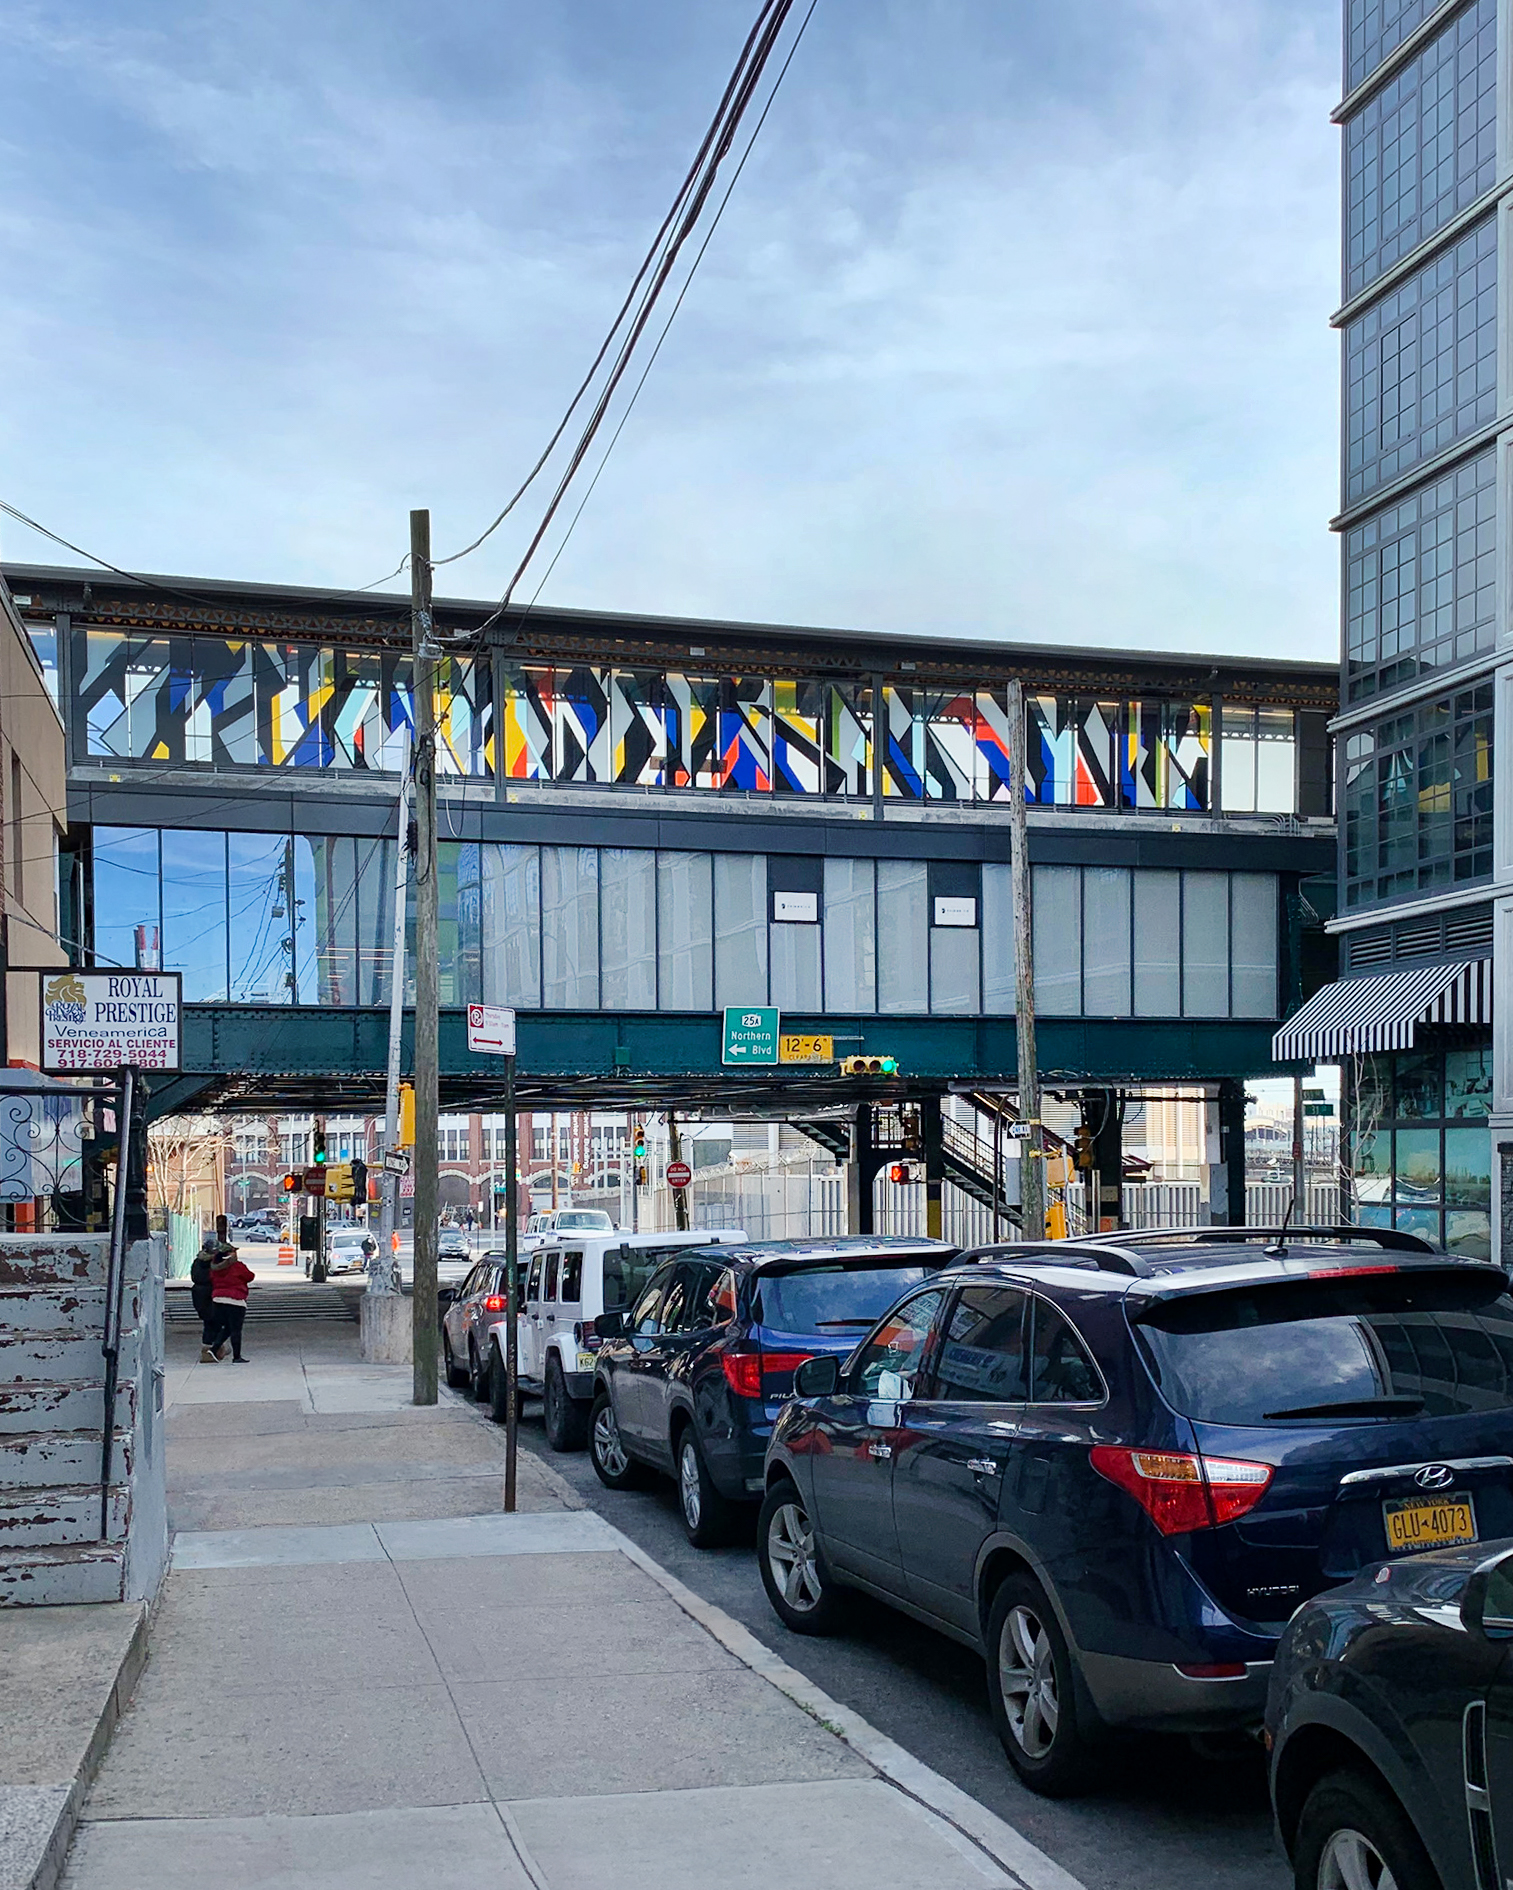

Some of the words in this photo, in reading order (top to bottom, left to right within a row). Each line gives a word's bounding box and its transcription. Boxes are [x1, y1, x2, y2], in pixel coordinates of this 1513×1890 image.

[108, 977, 163, 998] ROYAL
[94, 1002, 176, 1023] PRESTIGE
[743, 1016, 760, 1027] 25A
[54, 1024, 167, 1037] Veneamerica
[731, 1031, 771, 1041] Northern
[47, 1039, 104, 1048] SERVICIO
[108, 1039, 122, 1048] AL
[126, 1039, 176, 1048] CLIENTE
[57, 1049, 167, 1058] 718-729-5044
[752, 1045, 772, 1055] Blvd
[57, 1059, 166, 1068] 917-6045801
[1404, 1501, 1425, 1511] NEW
[1427, 1498, 1450, 1507] YORK
[1393, 1511, 1420, 1539] GLU
[1431, 1507, 1467, 1534] 4073
